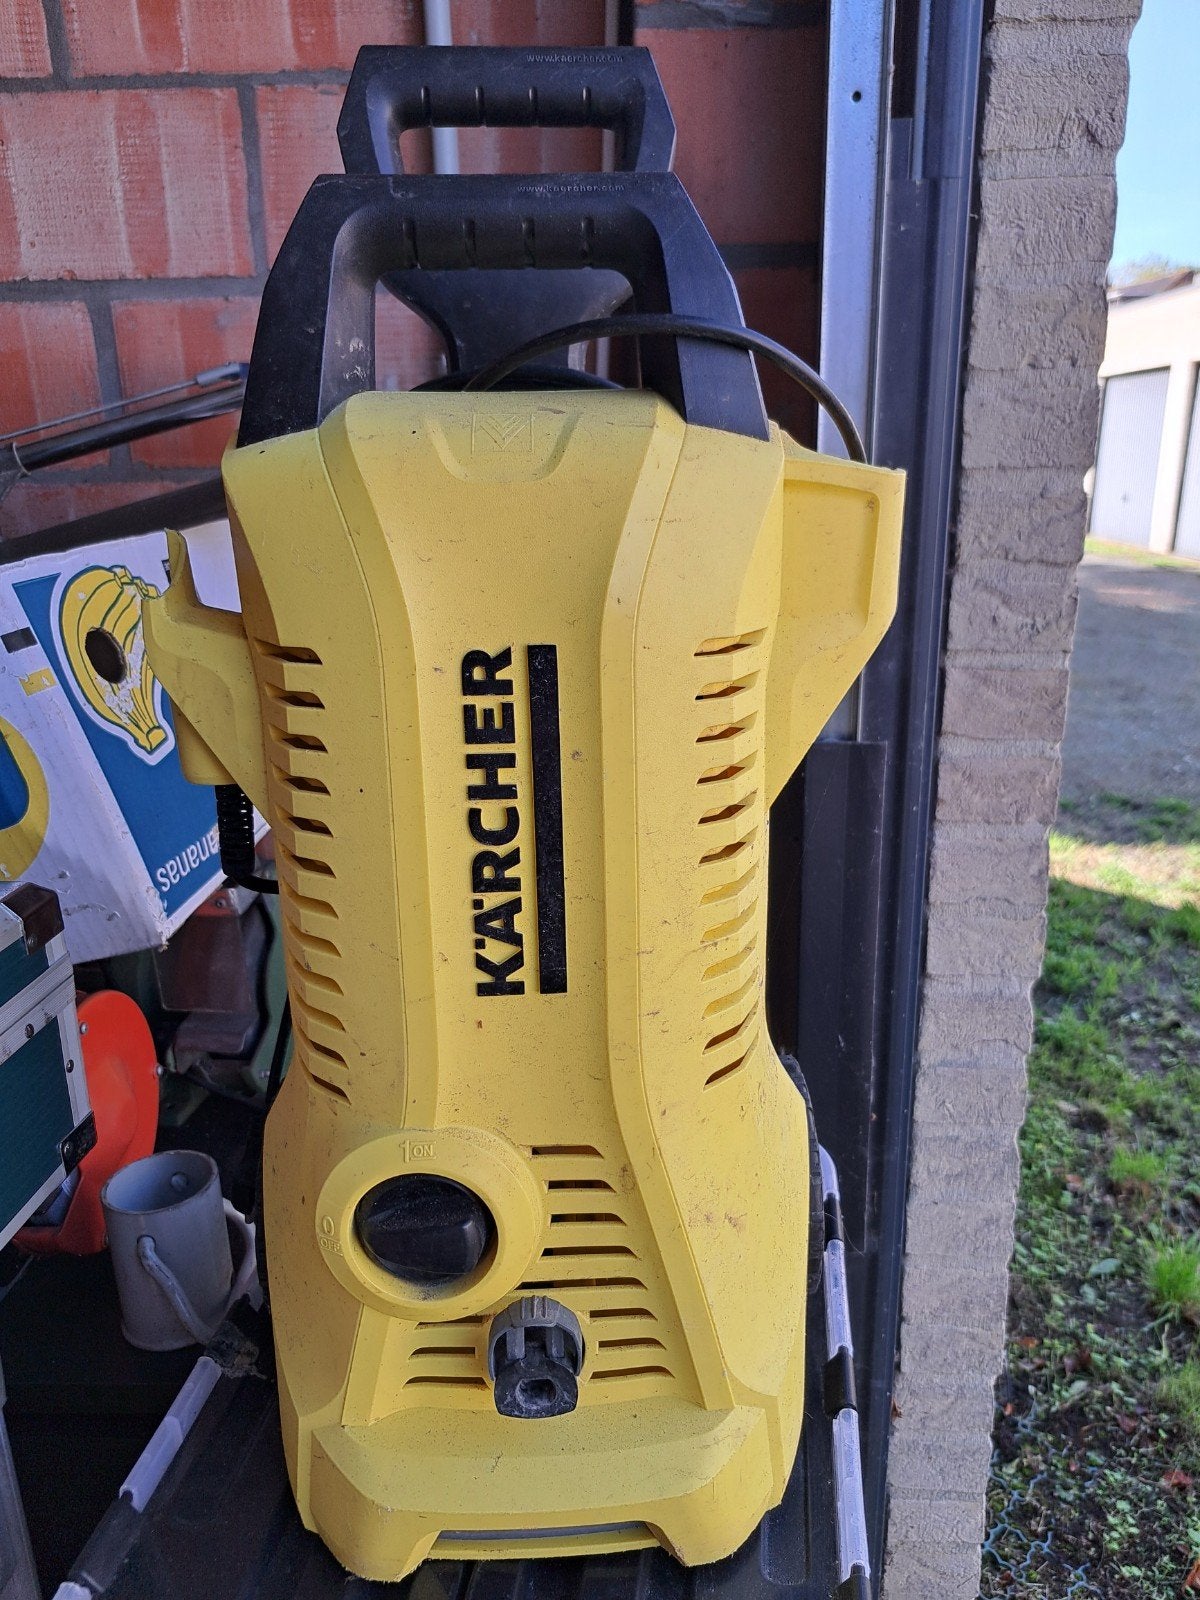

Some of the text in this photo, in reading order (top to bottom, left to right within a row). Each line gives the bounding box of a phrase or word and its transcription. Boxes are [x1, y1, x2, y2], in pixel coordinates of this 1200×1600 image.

[526, 54, 624, 63] www.kaercher.com
[517, 184, 625, 193] www.kaercher.com
[461, 645, 526, 997] KÄRCHER
[156, 823, 221, 892] ananas
[412, 1144, 434, 1157] ON
[320, 1237, 341, 1253] OFF
